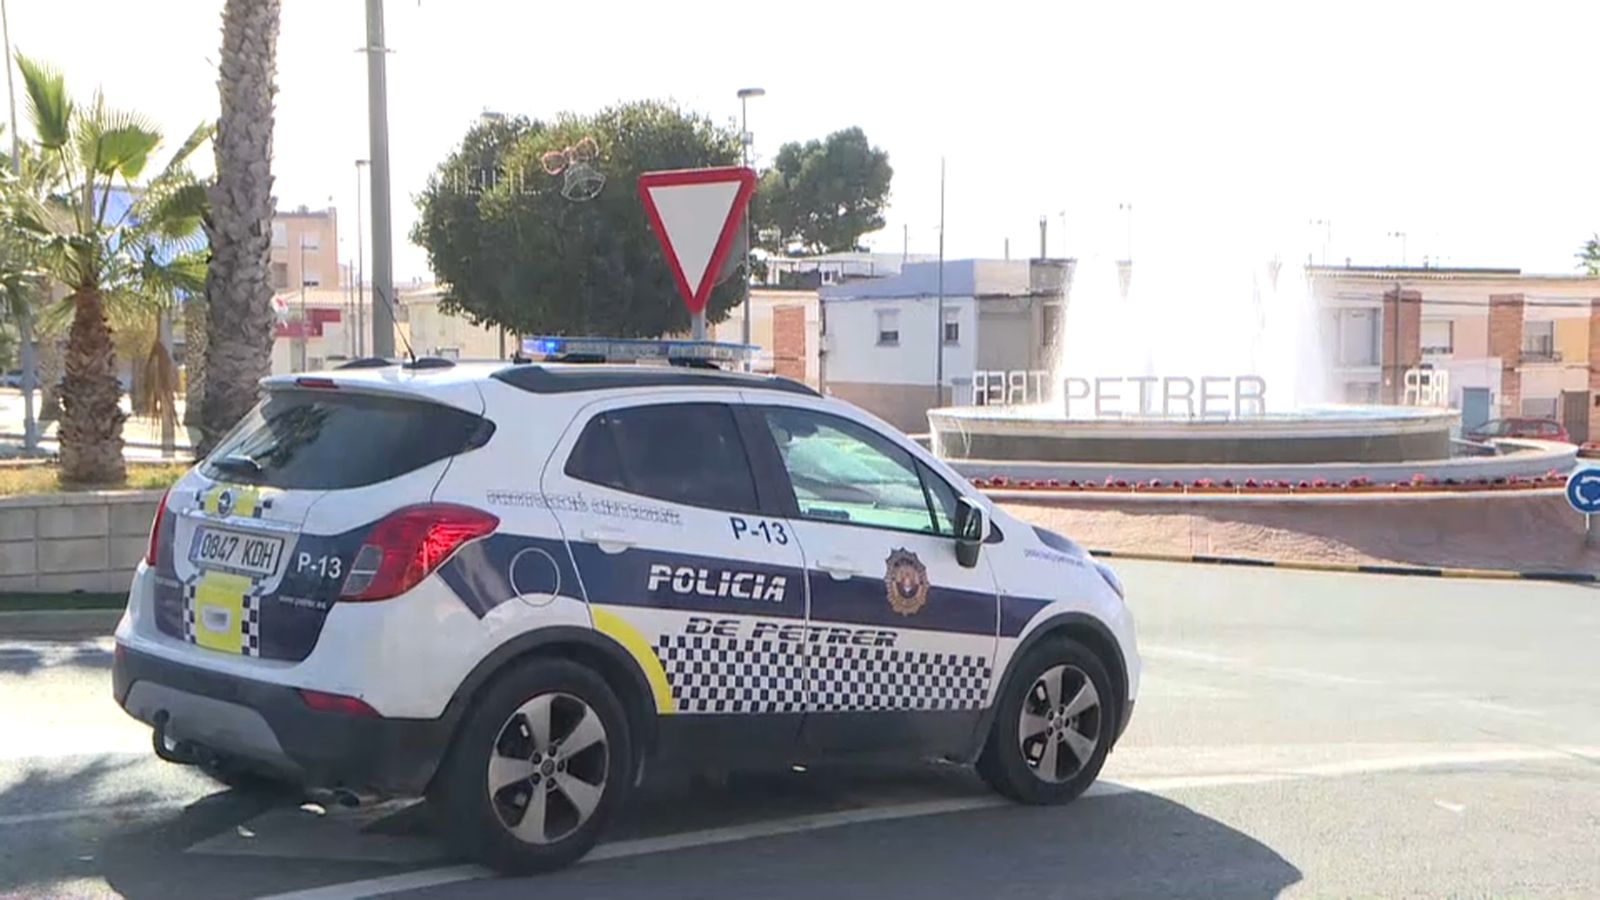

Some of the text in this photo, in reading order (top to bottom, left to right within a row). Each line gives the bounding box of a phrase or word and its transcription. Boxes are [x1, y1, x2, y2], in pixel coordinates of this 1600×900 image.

[1063, 376, 1267, 421] PETRER
[731, 516, 789, 545] P-13
[201, 532, 275, 569] 0847 KDH
[297, 552, 341, 578] P-13
[648, 564, 786, 602] POLICIA
[685, 617, 898, 647] DE PETRER
